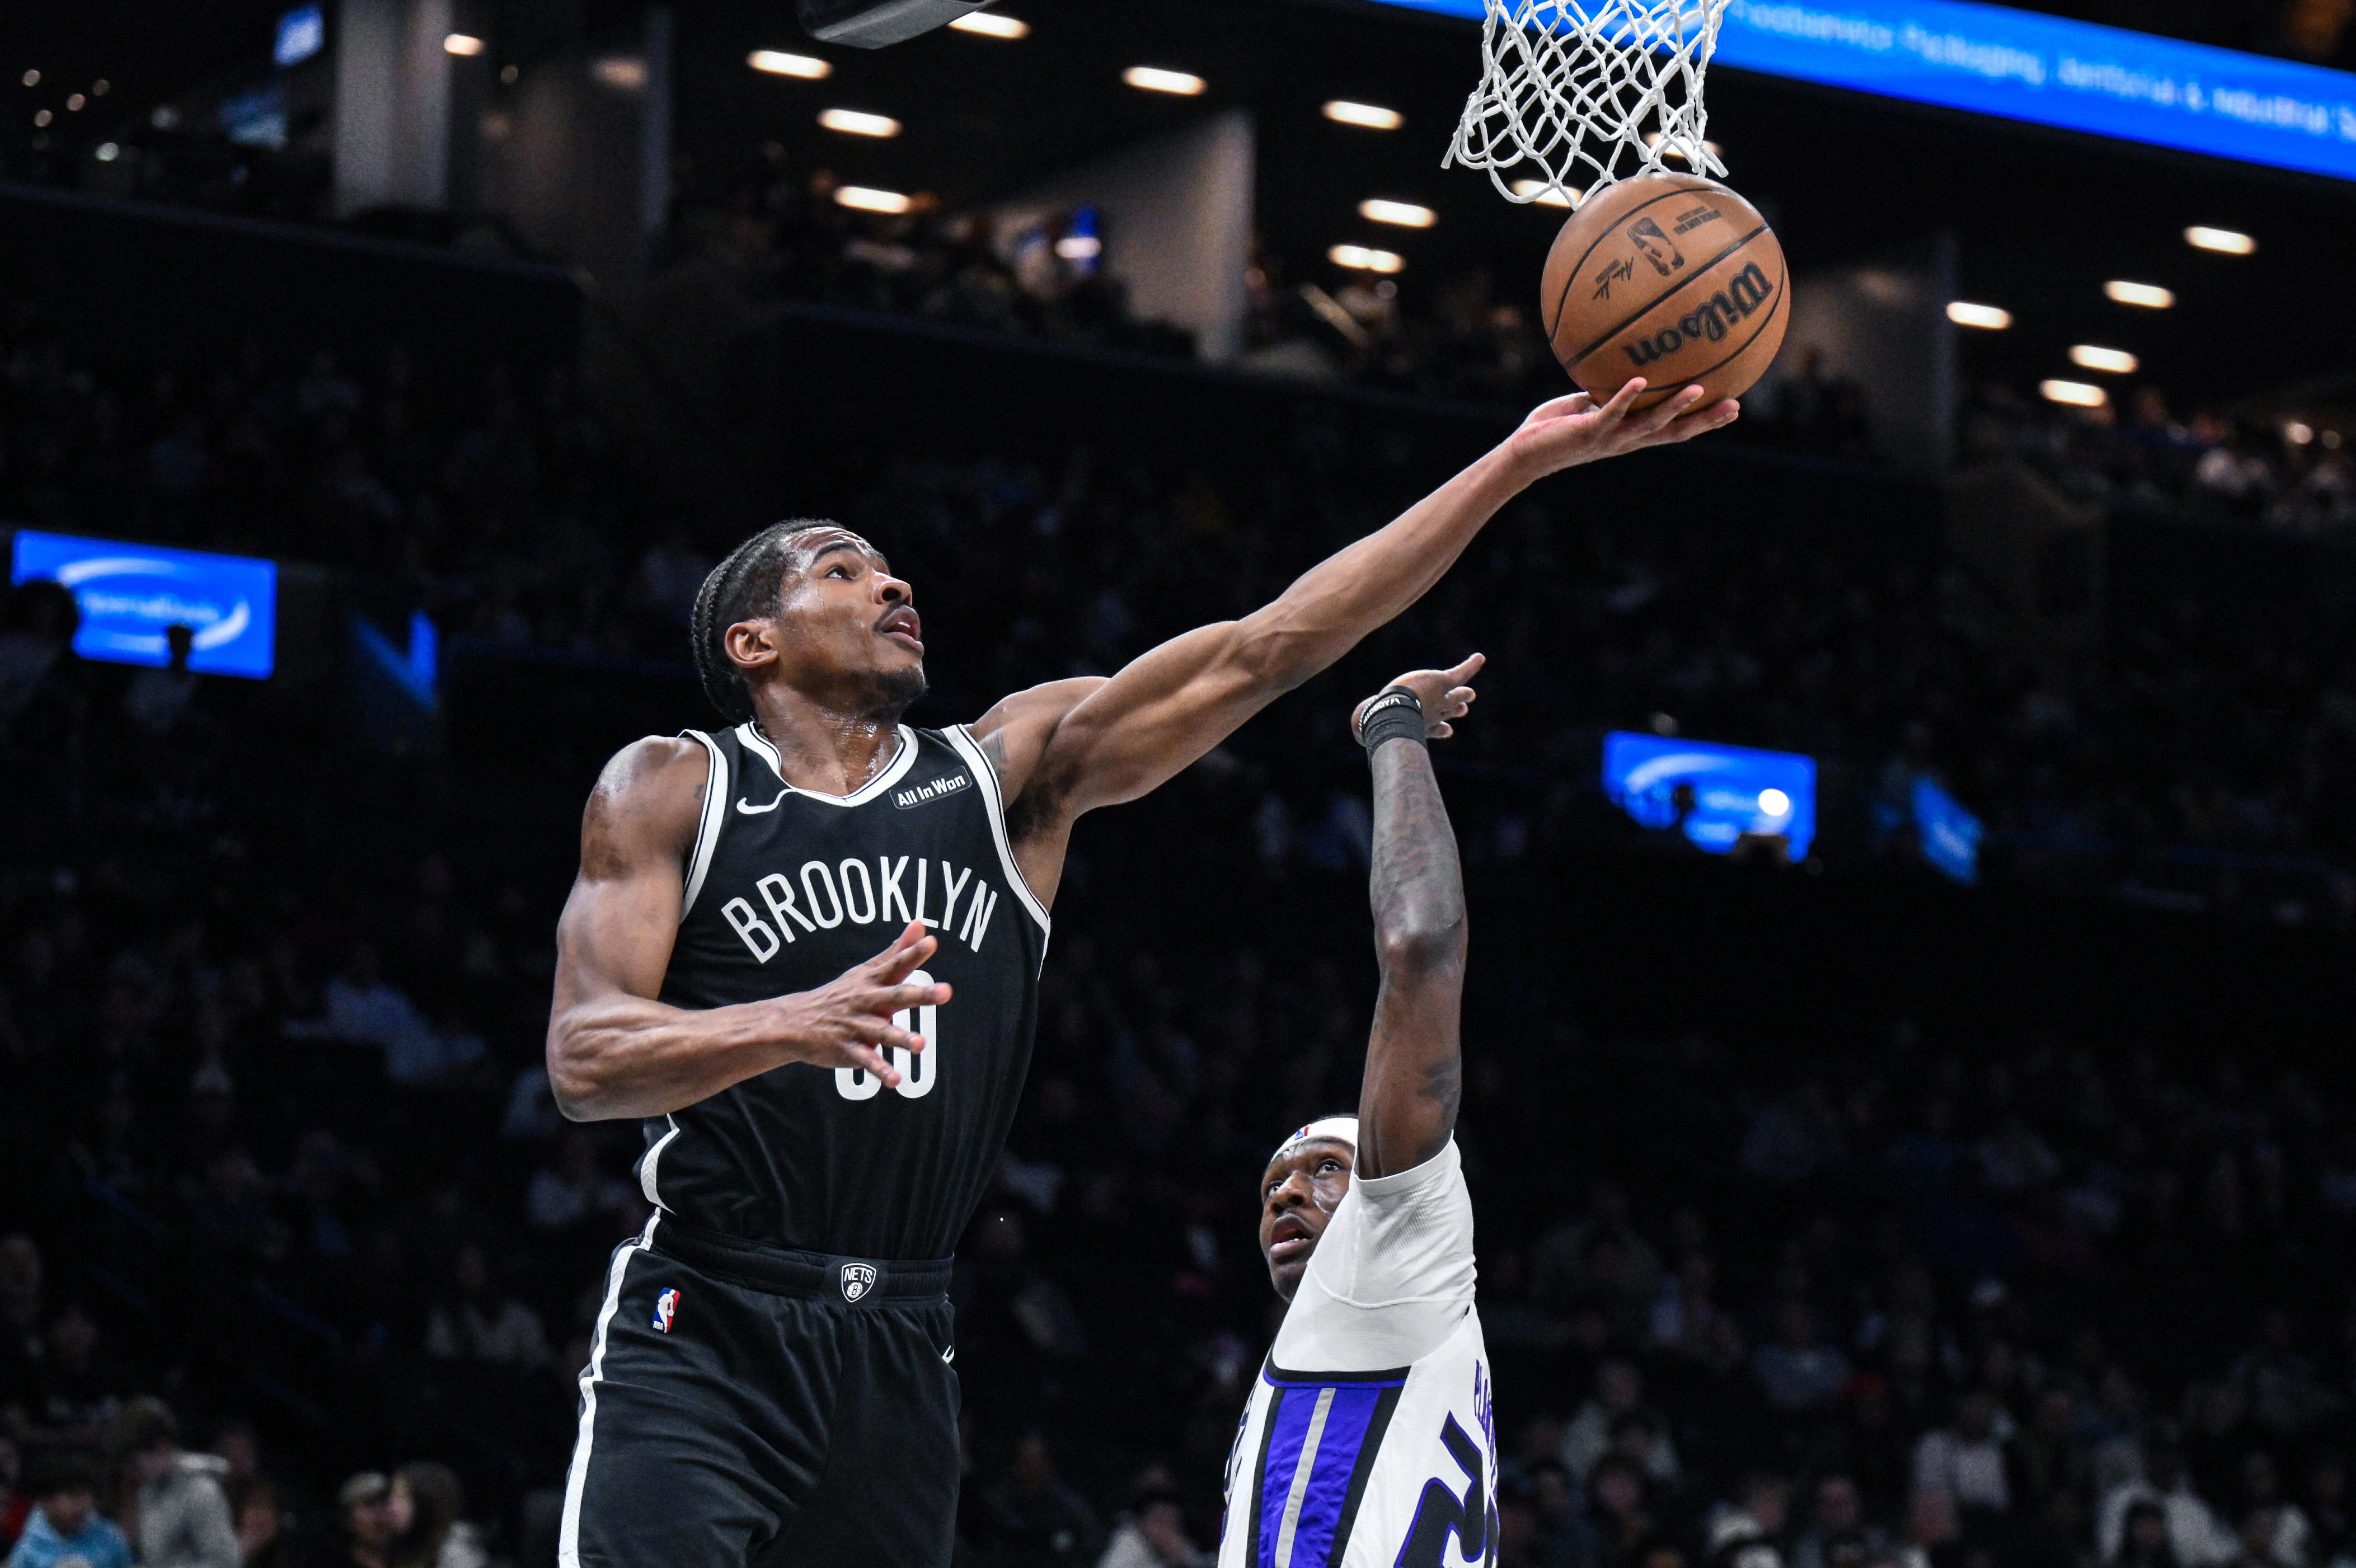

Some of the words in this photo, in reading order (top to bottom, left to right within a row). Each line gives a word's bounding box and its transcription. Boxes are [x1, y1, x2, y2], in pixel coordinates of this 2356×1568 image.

[1622, 261, 1773, 367] Wilson
[898, 790, 918, 806] All
[916, 786, 934, 800] In
[931, 775, 966, 795] Won
[721, 856, 998, 964] BROOKLYN
[844, 1267, 873, 1284] NETS
